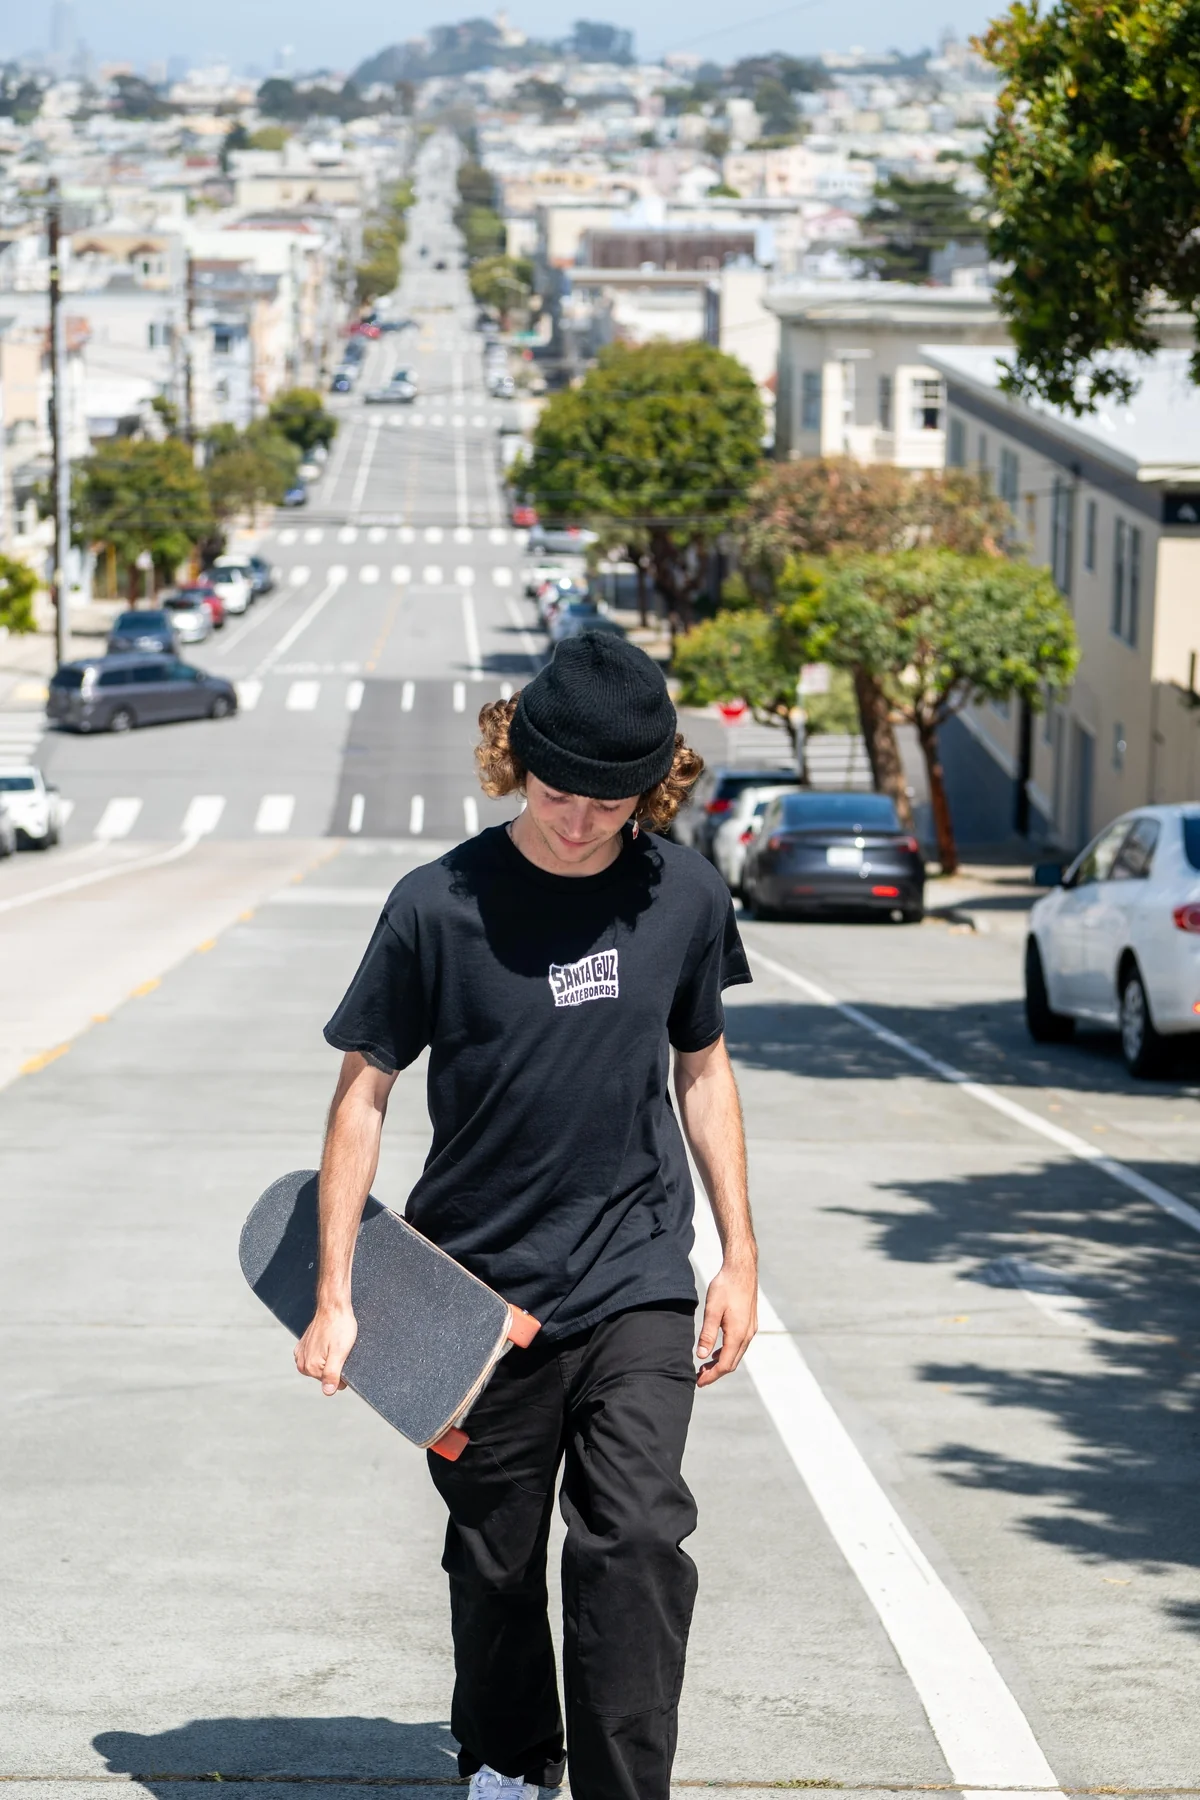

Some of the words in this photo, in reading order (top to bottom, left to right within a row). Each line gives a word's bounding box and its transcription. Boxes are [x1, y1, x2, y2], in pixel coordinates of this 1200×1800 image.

[551, 962, 592, 994] SANTA
[591, 955, 616, 982] CRUZ
[557, 984, 616, 1005] SKATEBOARDS
